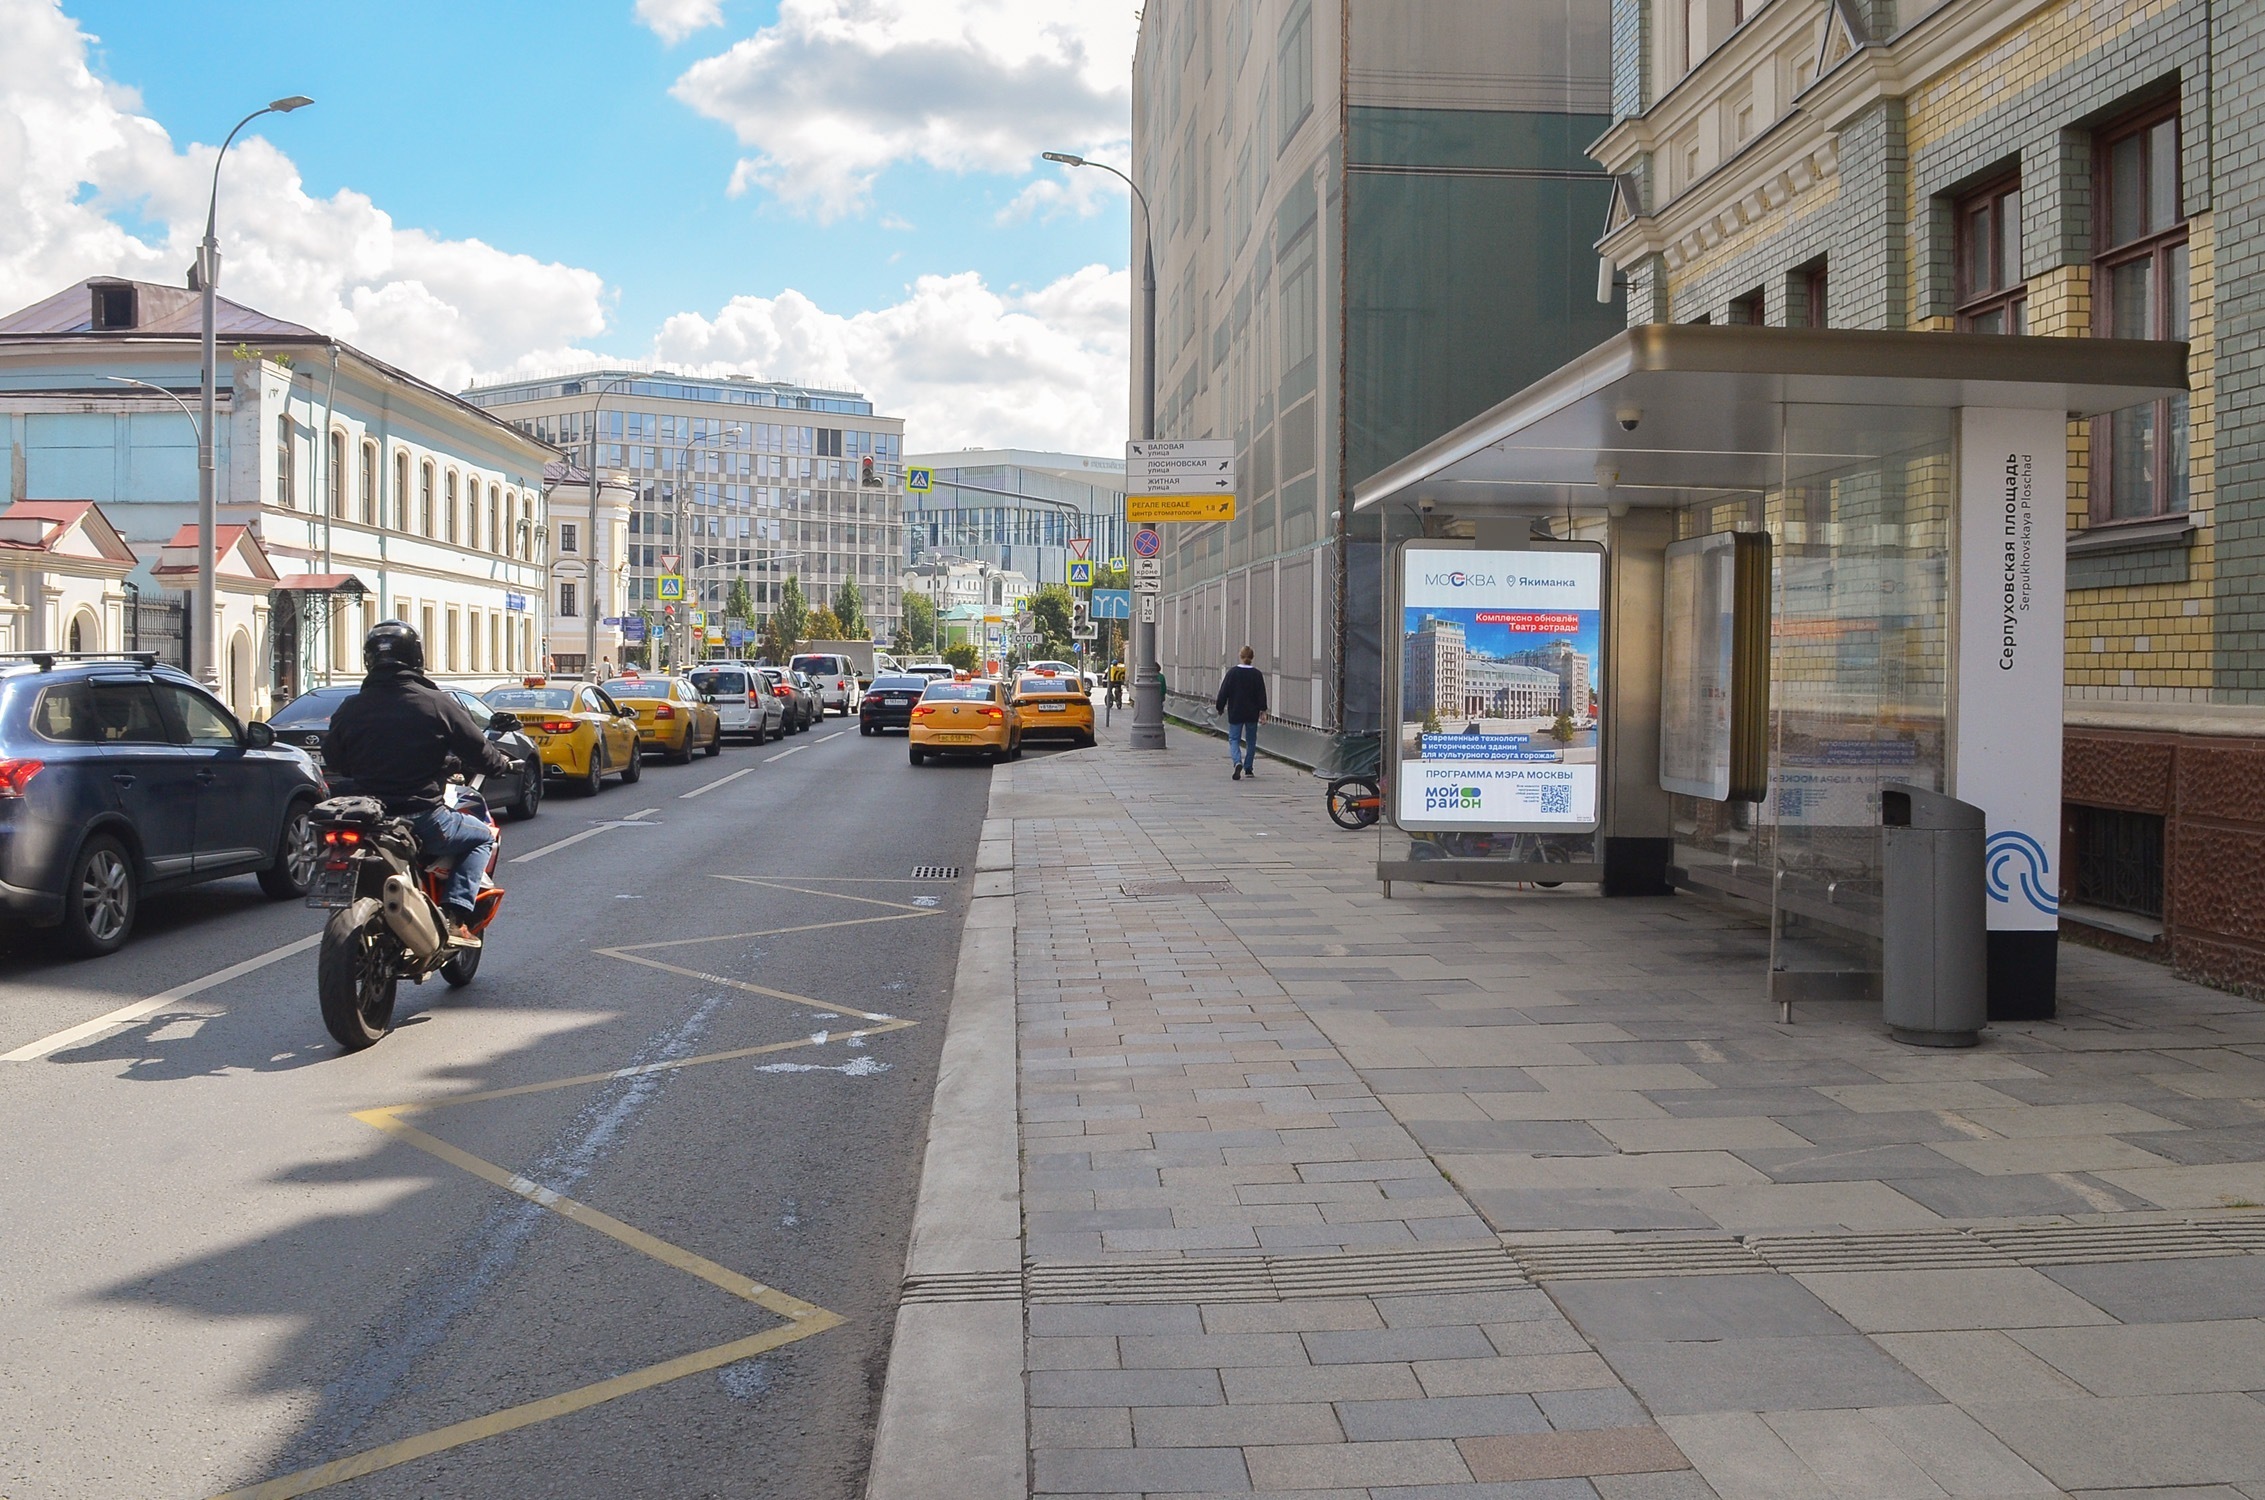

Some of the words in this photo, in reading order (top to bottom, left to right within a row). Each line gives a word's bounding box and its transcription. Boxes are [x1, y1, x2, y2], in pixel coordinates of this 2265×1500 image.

[2021, 454, 2032, 508] Ploschad
[2005, 453, 2018, 536] площадь
[2020, 512, 2032, 610] Serpukhovskaya
[1425, 571, 1496, 588] МОСКВА
[1519, 577, 1576, 587] Якиманка
[2000, 542, 2018, 670] Серпуховская
[1476, 613, 1532, 622] Комплексно
[1534, 614, 1578, 622] обновлён
[1510, 623, 1536, 632] Театр
[1538, 624, 1578, 632] эстрады
[1422, 734, 1479, 743] Современные
[1426, 770, 1492, 779] ПРОГРАММА
[1495, 770, 1524, 779] МЭРА
[1526, 771, 1573, 779] МОСКВЫ
